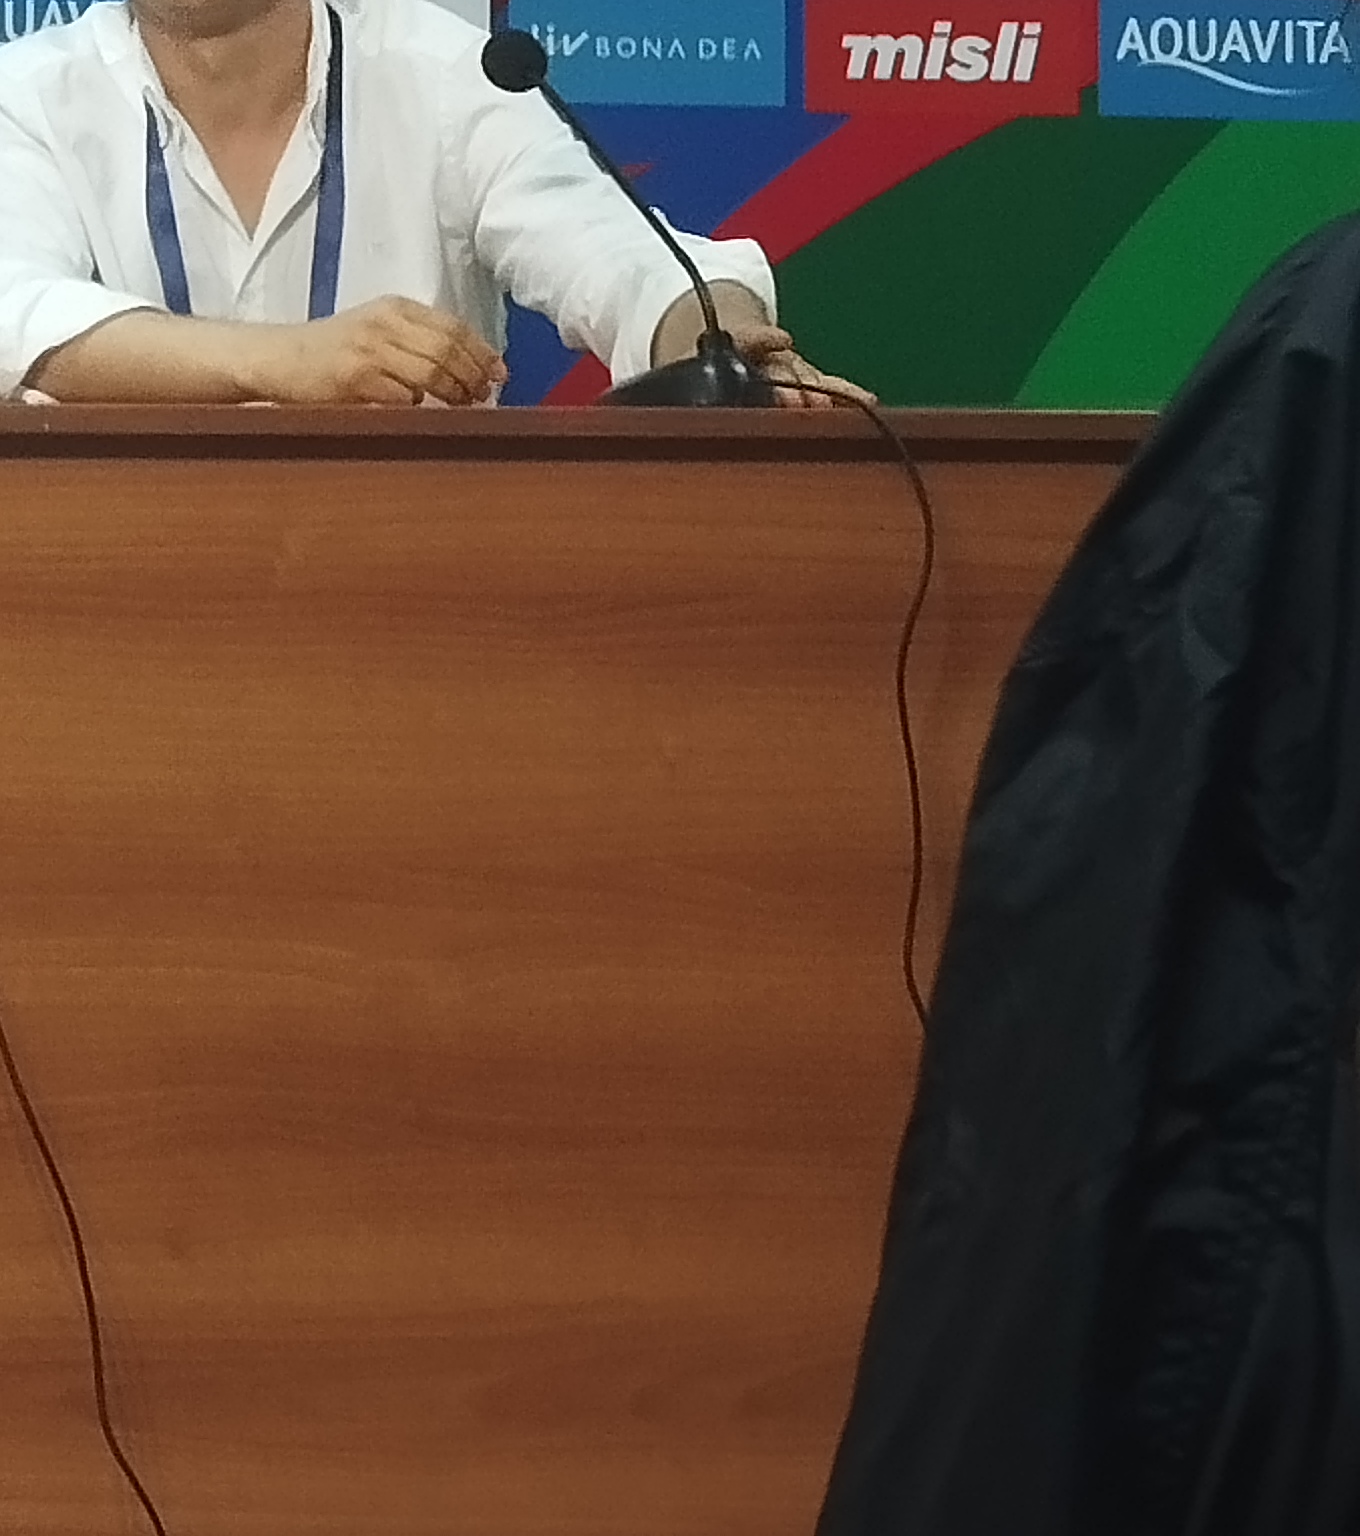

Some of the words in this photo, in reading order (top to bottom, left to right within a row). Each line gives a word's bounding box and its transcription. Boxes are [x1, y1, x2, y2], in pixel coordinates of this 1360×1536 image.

[595, 35, 687, 60] BONA
[697, 37, 762, 61] DEA
[842, 21, 1043, 85] misli
